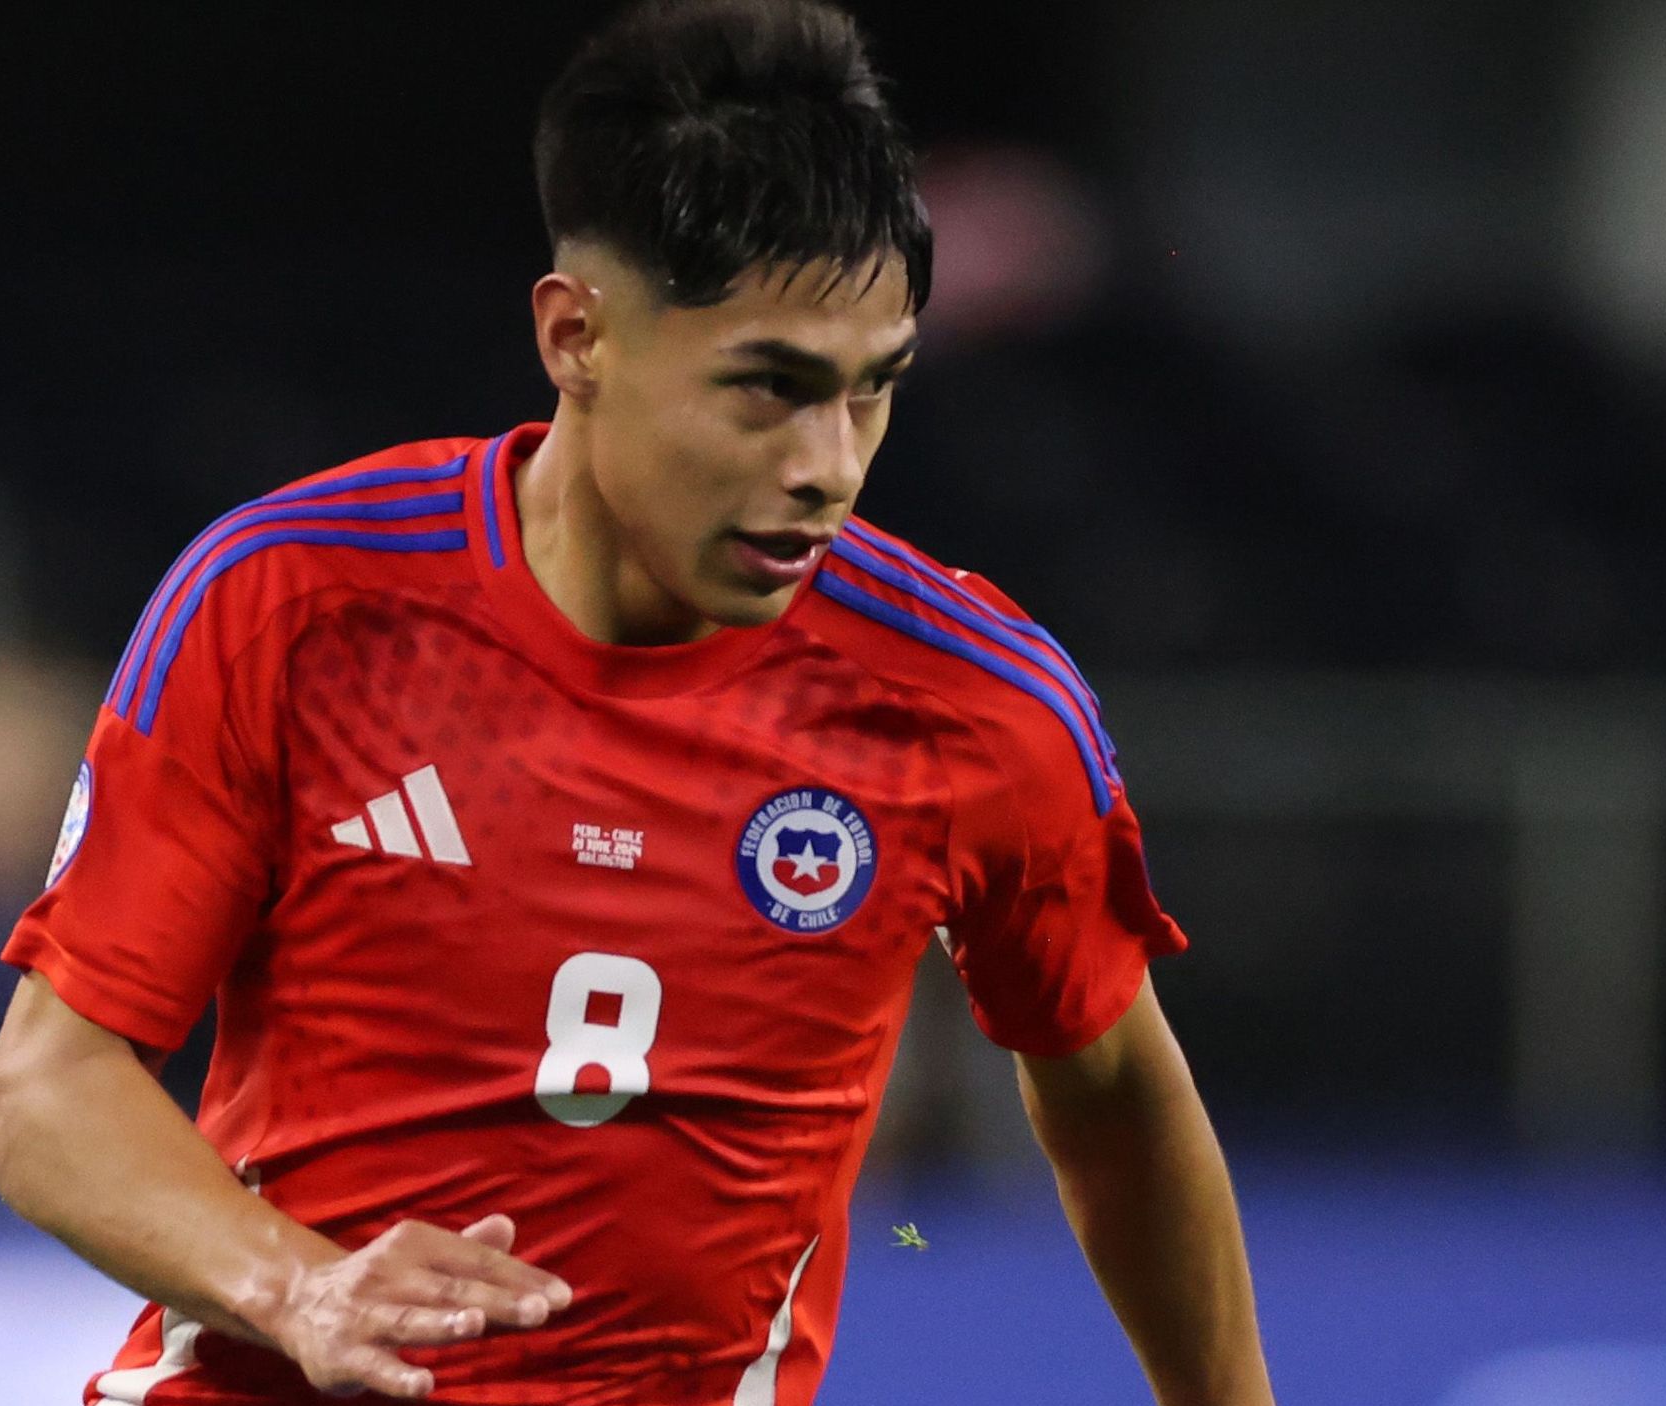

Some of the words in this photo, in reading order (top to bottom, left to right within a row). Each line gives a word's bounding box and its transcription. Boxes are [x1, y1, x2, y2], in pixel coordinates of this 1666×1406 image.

[740, 791, 812, 857] FEDERACION
[822, 795, 843, 815] DE
[843, 812, 873, 867] FUTBOL
[770, 906, 791, 924] DE
[798, 906, 839, 928] CHILE
[535, 951, 662, 1128] 8
